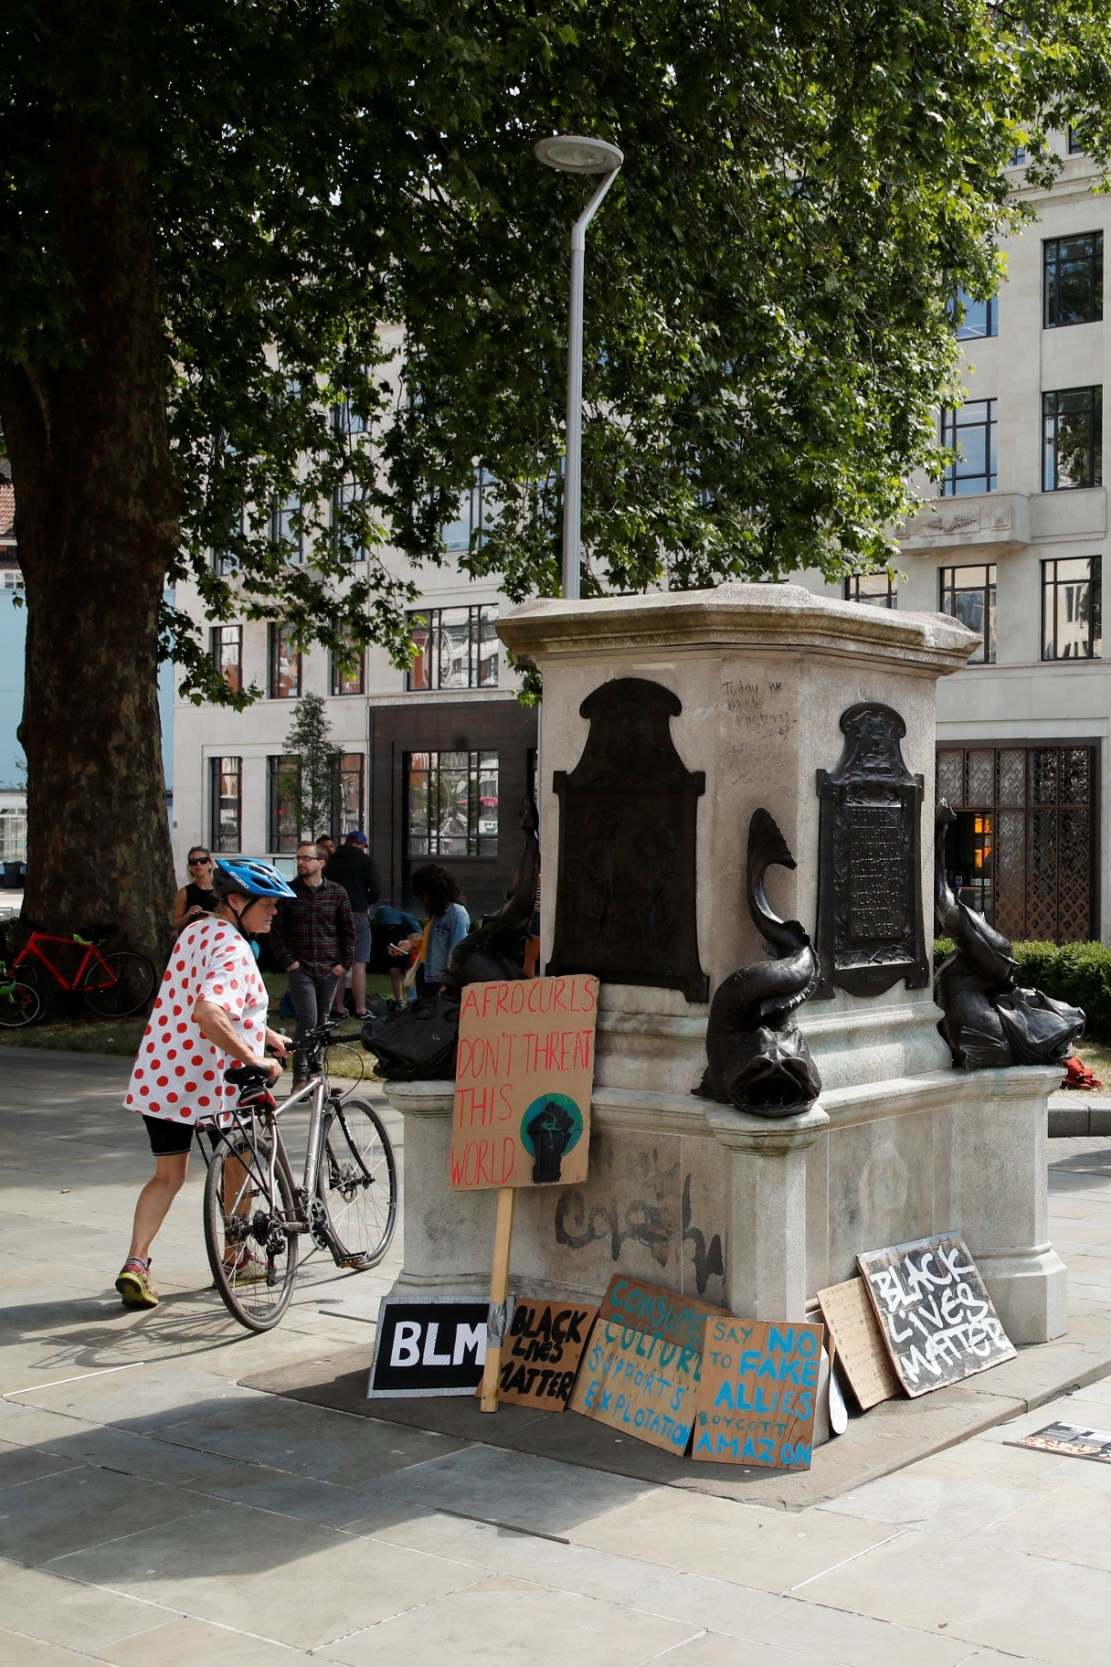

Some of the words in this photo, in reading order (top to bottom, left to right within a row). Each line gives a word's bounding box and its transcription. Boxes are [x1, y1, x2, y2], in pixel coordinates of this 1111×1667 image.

[461, 978, 597, 1019] AFROCURLS
[457, 1032, 516, 1080] DON'T
[522, 1030, 594, 1074] THREAT
[456, 1083, 513, 1128] THIS
[451, 1137, 516, 1186] WORLD
[871, 1246, 976, 1312] BLACK
[390, 1321, 488, 1367] BLM
[510, 1305, 587, 1344] BLACK
[714, 1323, 754, 1344] SAY
[768, 1327, 817, 1358] NO
[710, 1351, 732, 1369] TO
[738, 1351, 817, 1388] FAKE
[901, 1317, 1013, 1383] MATTER
[713, 1380, 813, 1421] ALLIES
[698, 1411, 789, 1439] BOYCOTT
[696, 1431, 813, 1466] AMAZON
